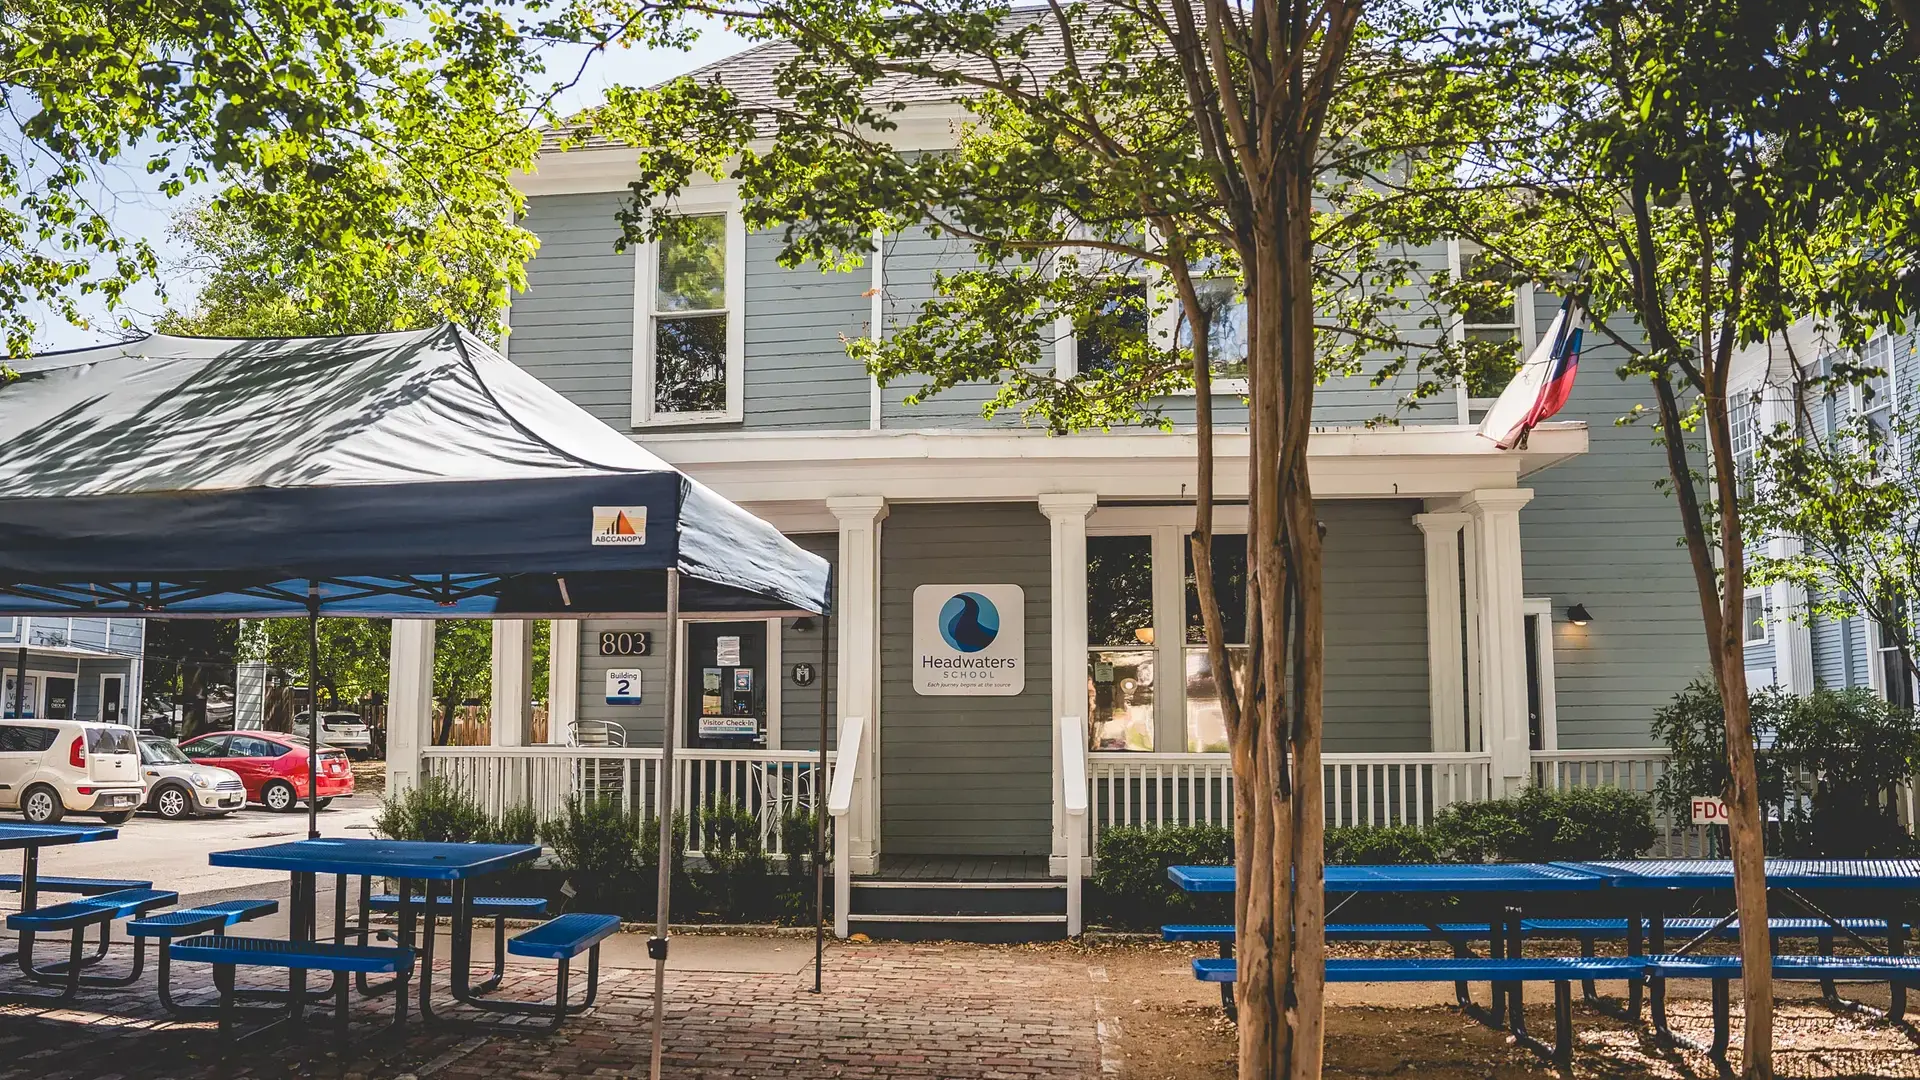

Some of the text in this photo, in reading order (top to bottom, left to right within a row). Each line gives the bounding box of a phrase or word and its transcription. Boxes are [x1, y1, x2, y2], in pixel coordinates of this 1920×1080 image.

[602, 632, 646, 655] 803
[922, 655, 1016, 668] Headwaters
[610, 672, 638, 680] Building
[943, 671, 995, 679] SCHOOL
[617, 680, 630, 695] 2
